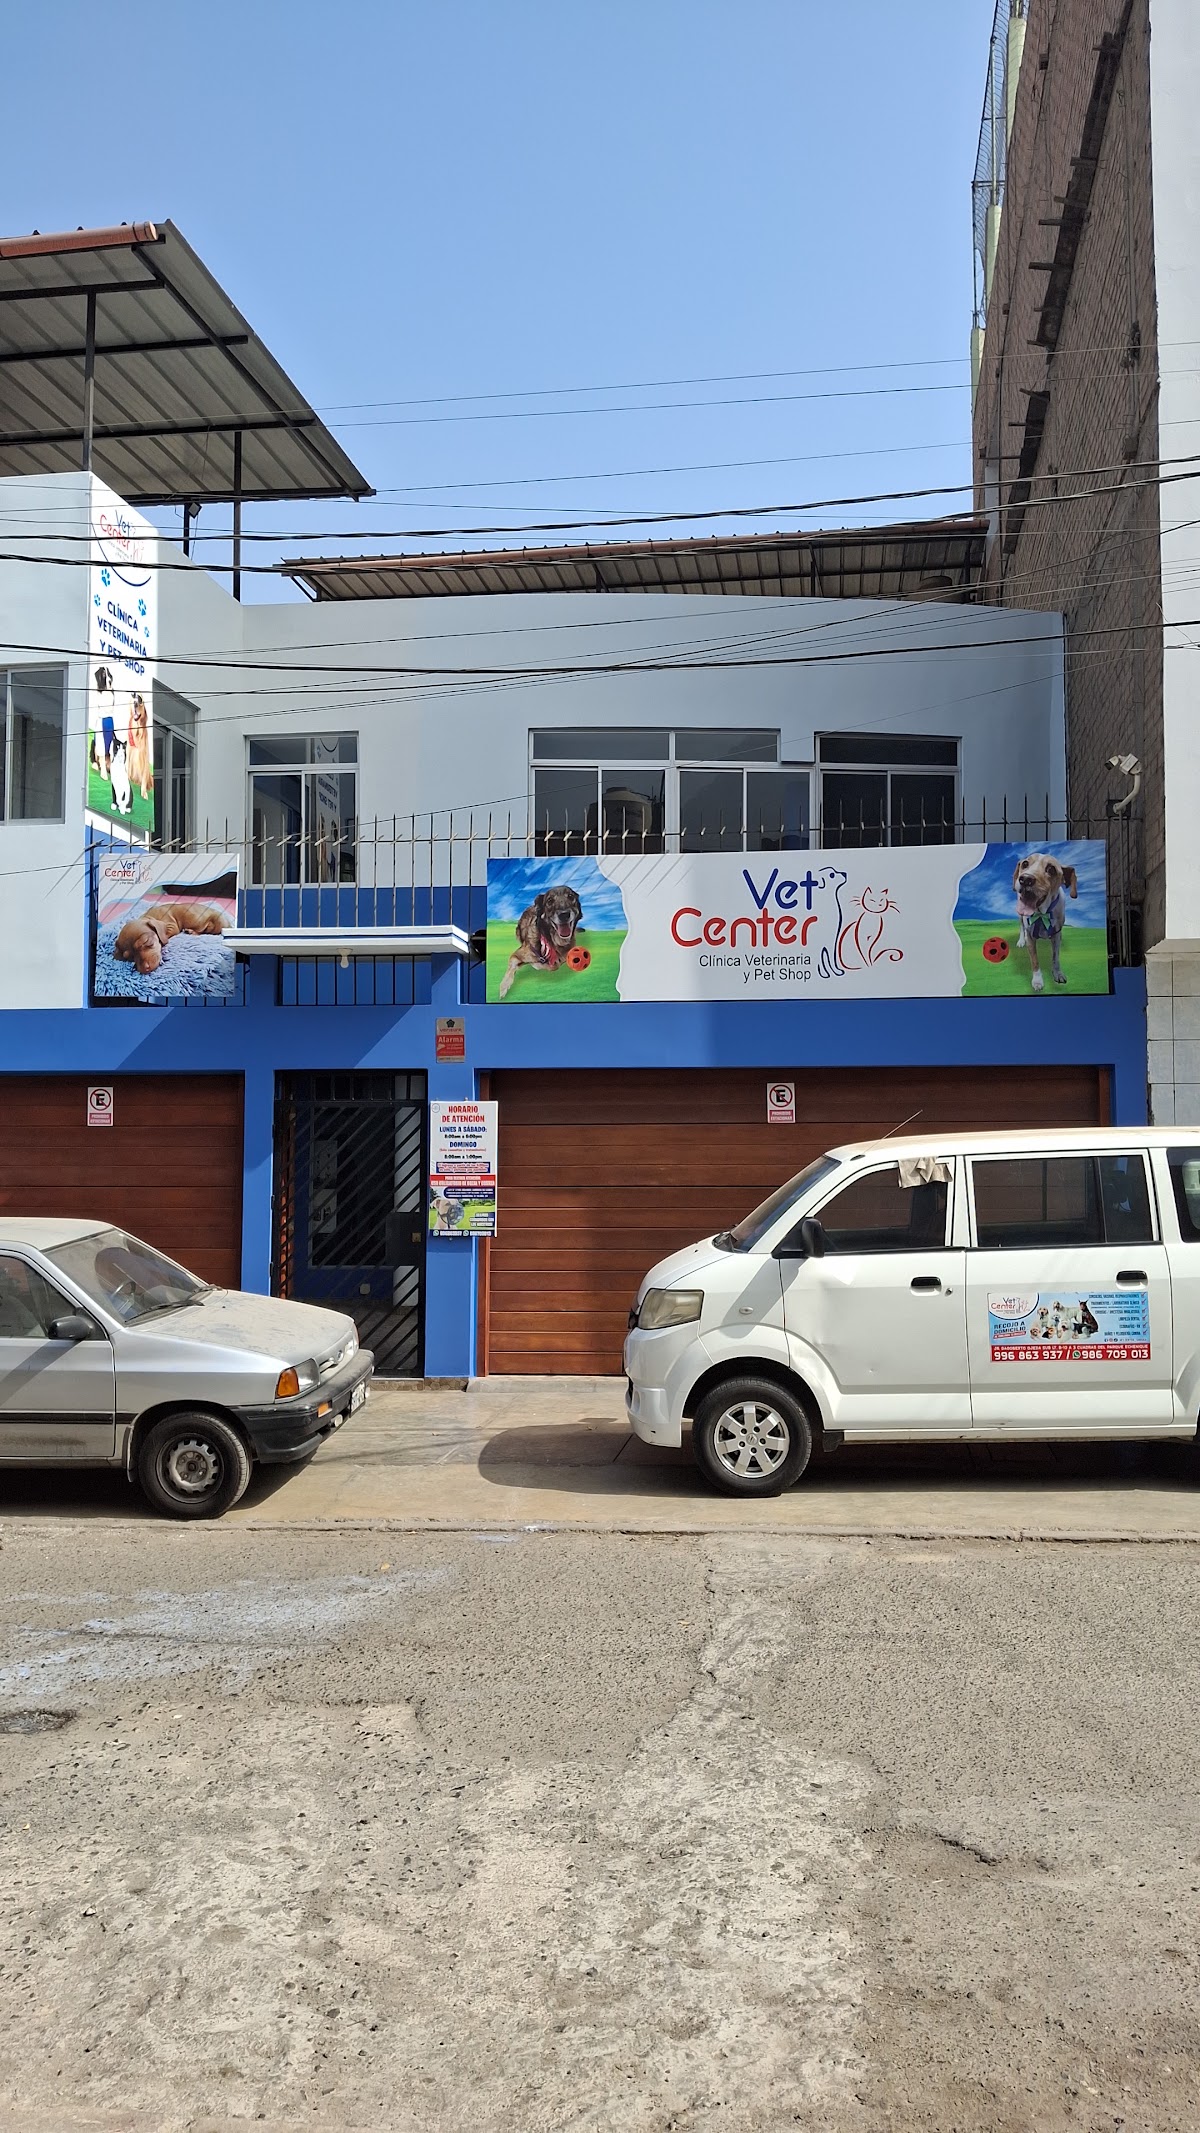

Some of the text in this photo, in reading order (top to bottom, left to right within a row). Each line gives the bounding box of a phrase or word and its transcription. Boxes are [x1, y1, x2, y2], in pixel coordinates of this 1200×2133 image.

[100, 514, 130, 550] Center
[115, 509, 130, 537] Vet
[107, 600, 139, 632] CLÍNICA
[97, 615, 148, 658] VETERINARIA
[100, 639, 145, 676] Y PET SHOP
[104, 868, 136, 878] Center
[120, 860, 136, 870] Vet
[742, 868, 818, 910] Vet
[670, 907, 818, 948] Center
[699, 954, 812, 967] Clínica Veterinaria
[743, 968, 812, 984] y Pet Shop
[452, 1113, 485, 1122] ATENCIÓN
[994, 1326, 1026, 1334] DOMICILIO
[994, 1352, 1015, 1360] 996
[1018, 1351, 1039, 1360] 863
[1042, 1351, 1063, 1359] 937
[1082, 1350, 1102, 1359] 986
[1106, 1350, 1127, 1358] 709
[1131, 1349, 1148, 1358] 013
